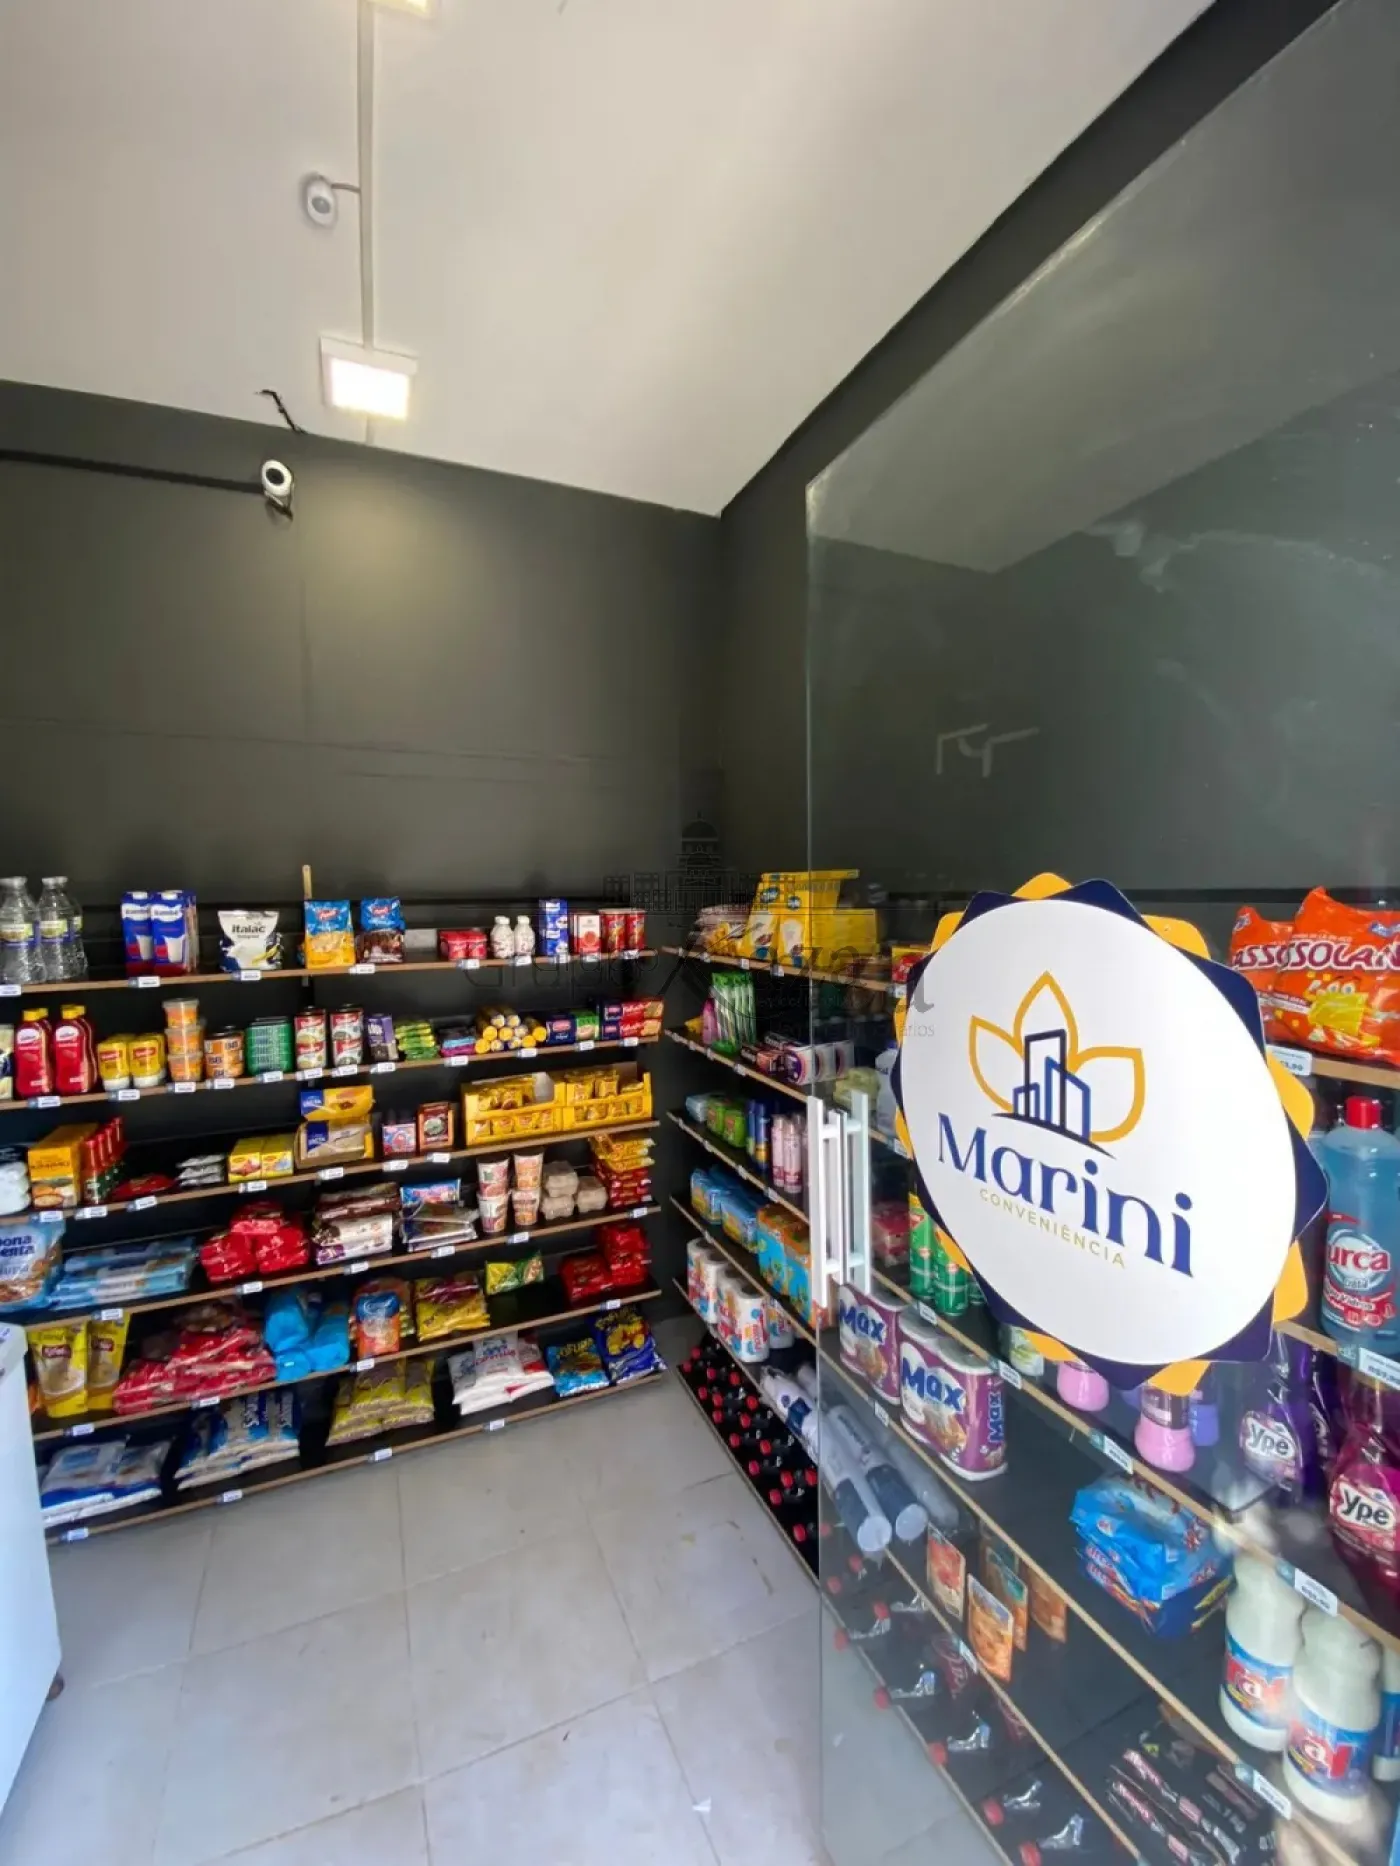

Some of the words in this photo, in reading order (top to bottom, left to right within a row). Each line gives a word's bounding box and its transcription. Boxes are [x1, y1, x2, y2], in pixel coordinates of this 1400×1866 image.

[938, 1112, 1194, 1278] Marini
[0, 1234, 33, 1247] ona
[0, 1245, 36, 1258] enta
[979, 1188, 1126, 1269] CONVENIÊNCIA
[902, 1356, 967, 1413] Max
[988, 1390, 1006, 1443] Max
